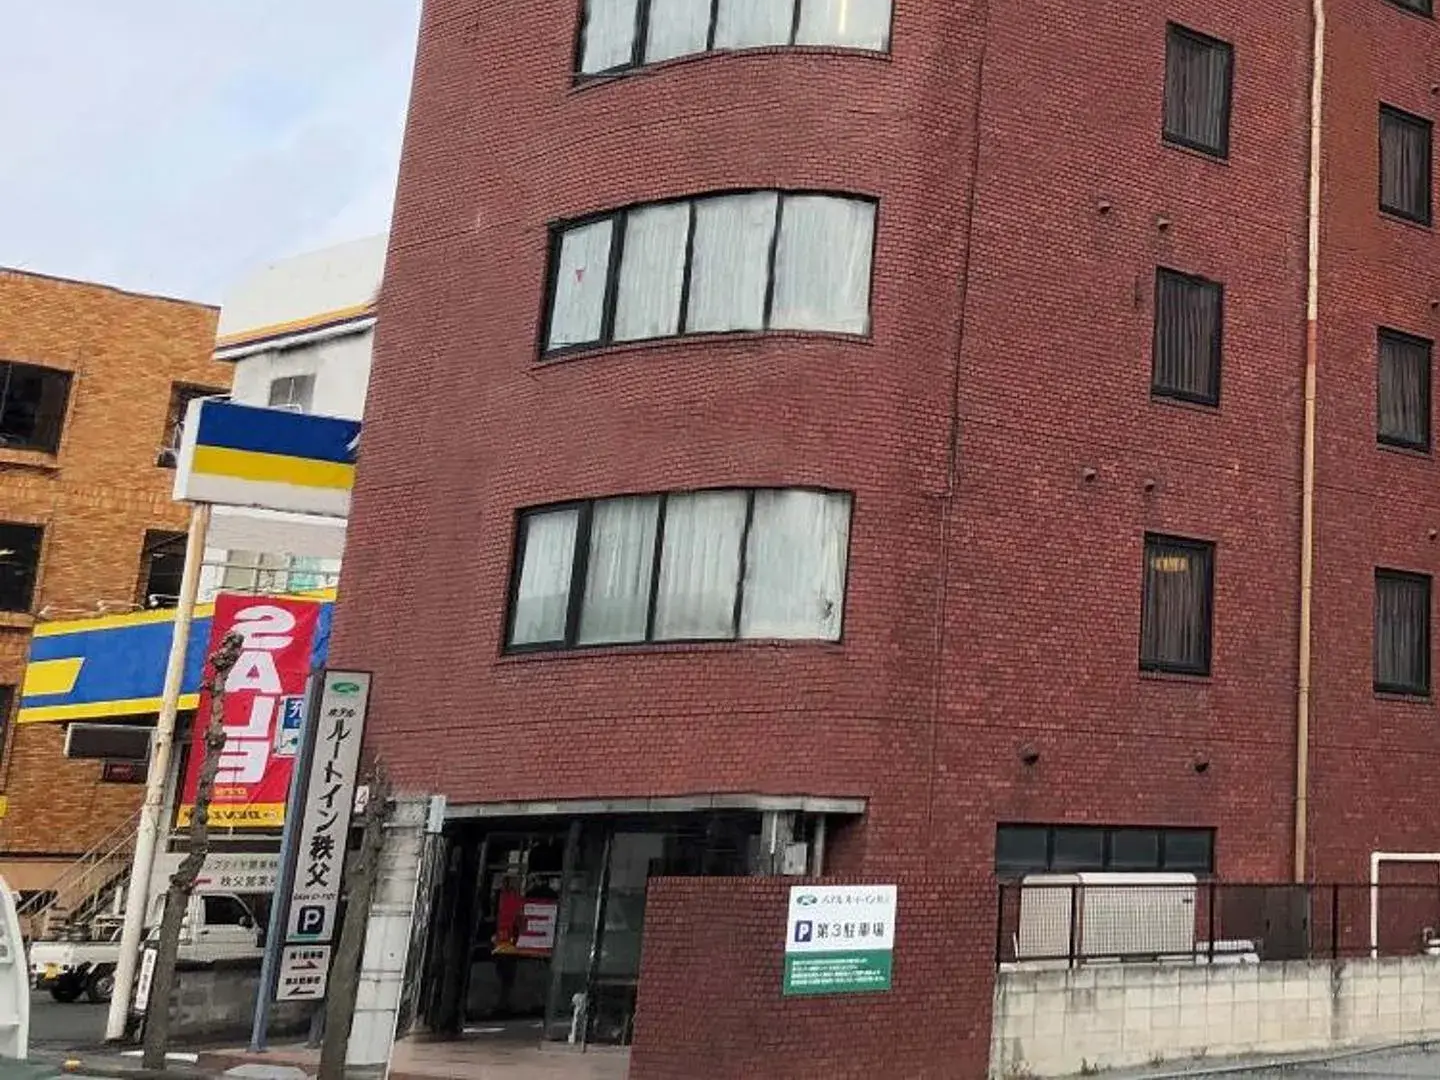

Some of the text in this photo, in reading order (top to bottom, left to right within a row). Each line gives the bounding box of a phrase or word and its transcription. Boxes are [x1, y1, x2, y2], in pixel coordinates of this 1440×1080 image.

[328, 707, 357, 719] ホテル
[305, 719, 352, 888] ルートイン秩父
